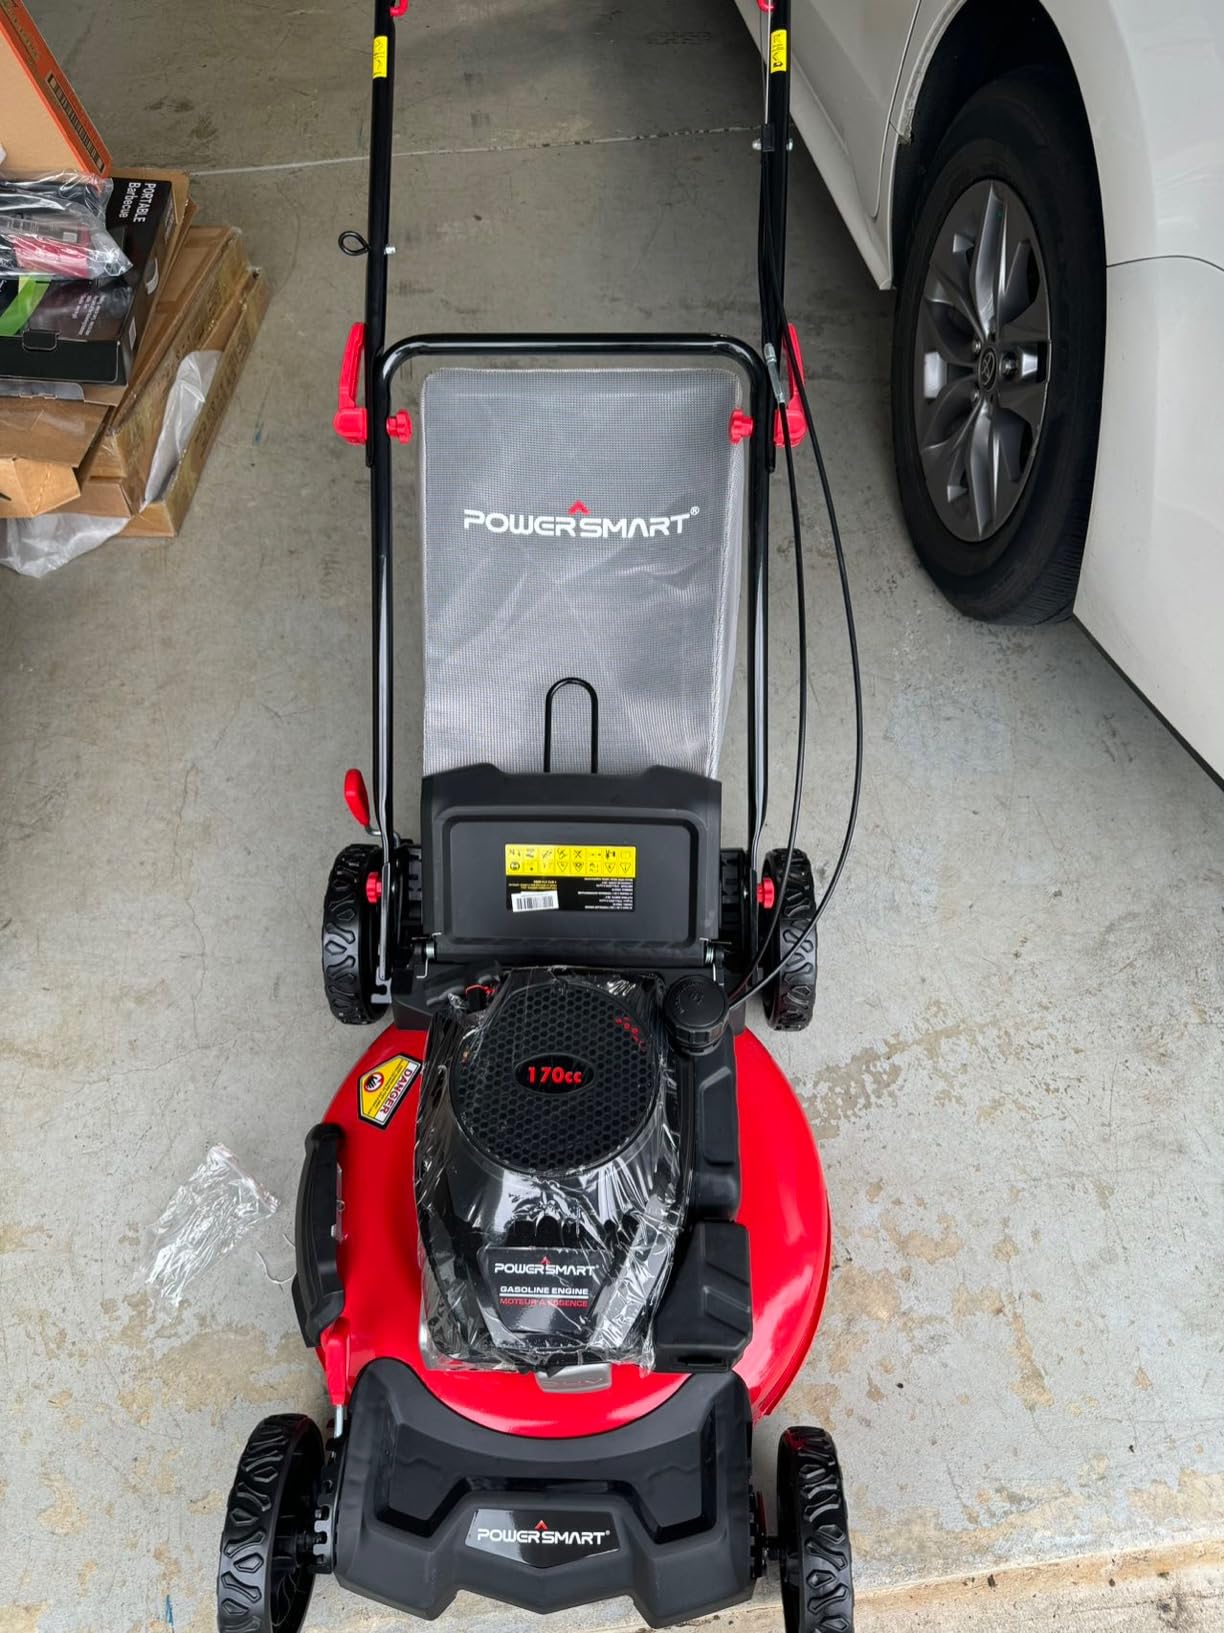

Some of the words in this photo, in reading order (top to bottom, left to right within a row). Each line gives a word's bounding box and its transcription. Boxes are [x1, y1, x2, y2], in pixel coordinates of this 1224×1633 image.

[119, 182, 141, 218] Barbecue
[133, 183, 156, 222] PORTABLE
[528, 1066, 583, 1084] 170cc
[380, 1068, 412, 1114] DANGER
[499, 1298, 537, 1307] MOTEUR
[500, 1285, 549, 1294] GASOLINE
